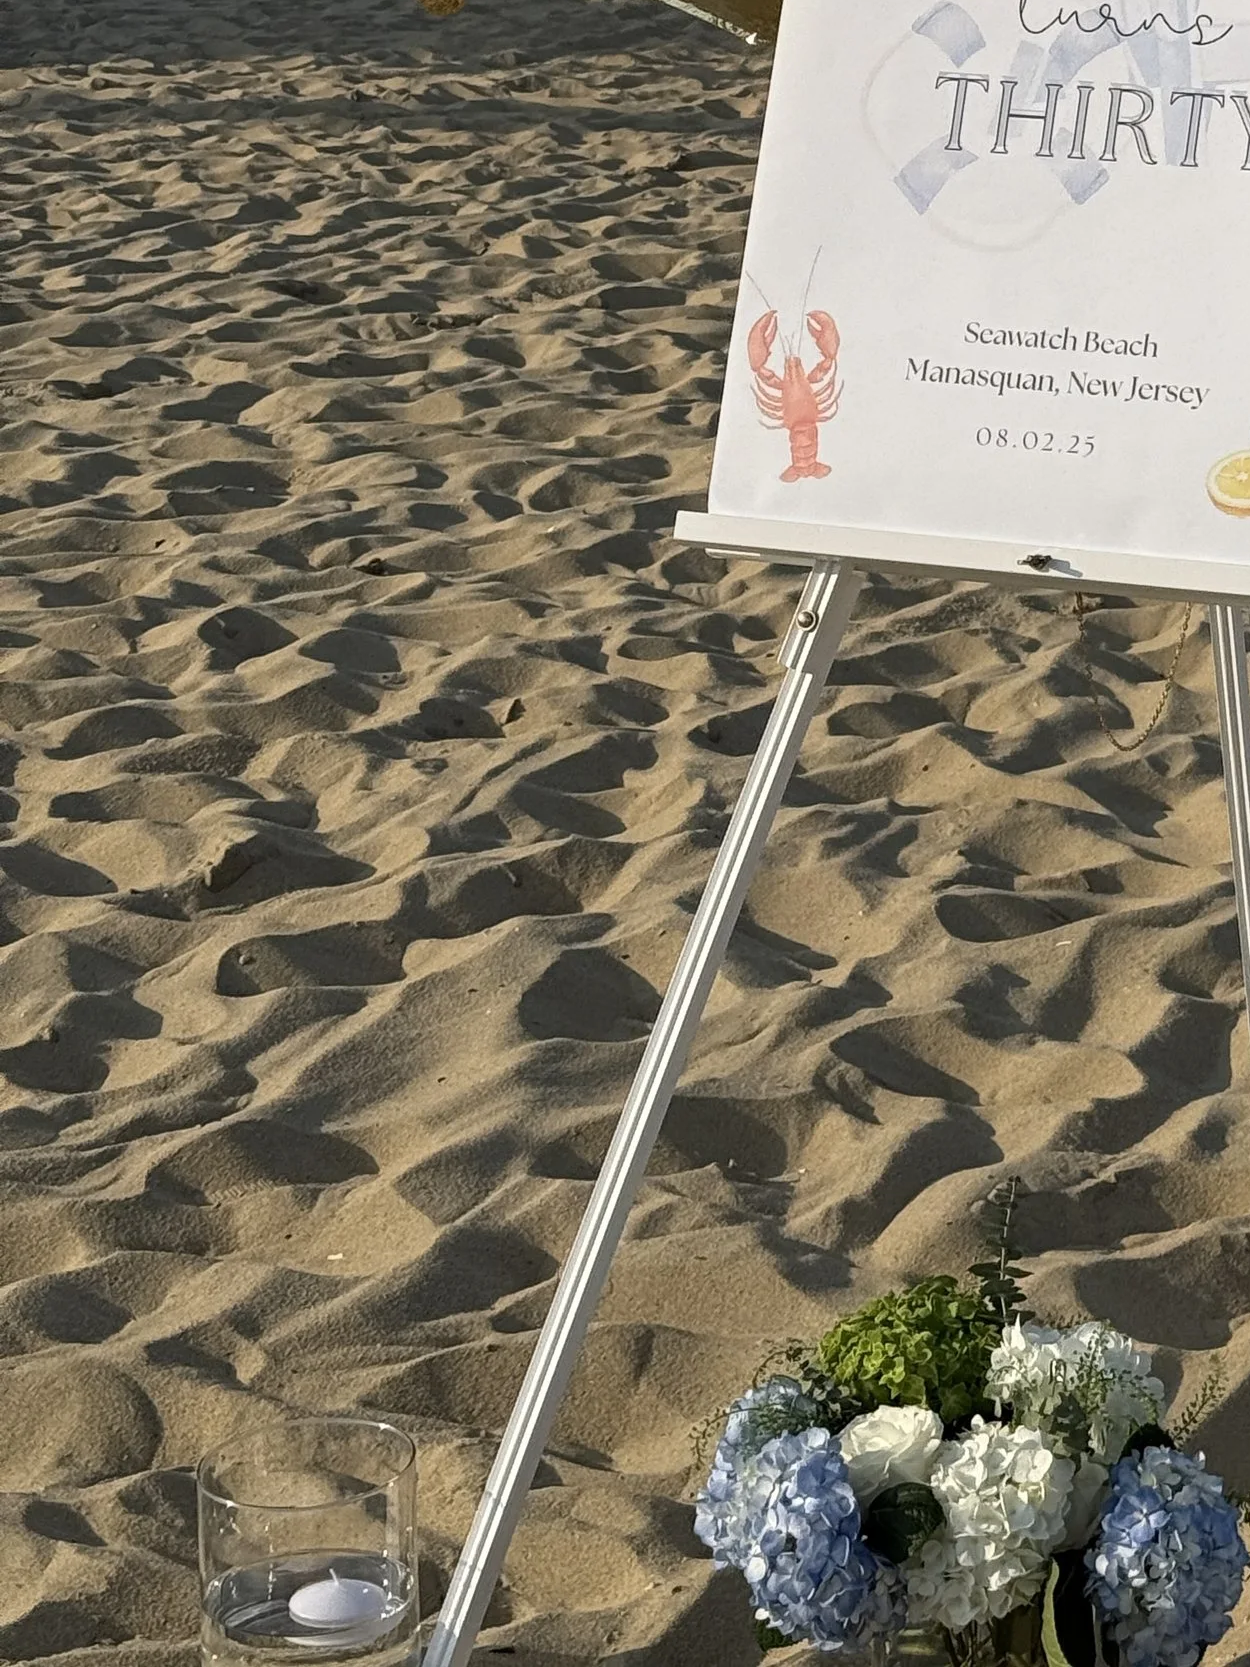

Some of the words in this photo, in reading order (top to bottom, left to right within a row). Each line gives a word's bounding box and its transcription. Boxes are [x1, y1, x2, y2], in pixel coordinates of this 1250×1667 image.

[963, 322, 1078, 352] Seawatch
[1083, 331, 1158, 358] Beach
[905, 358, 1060, 396] Manasquan,
[1066, 370, 1123, 398] New
[1123, 375, 1209, 409] Jersey
[976, 426, 1097, 457] 08.02.25
